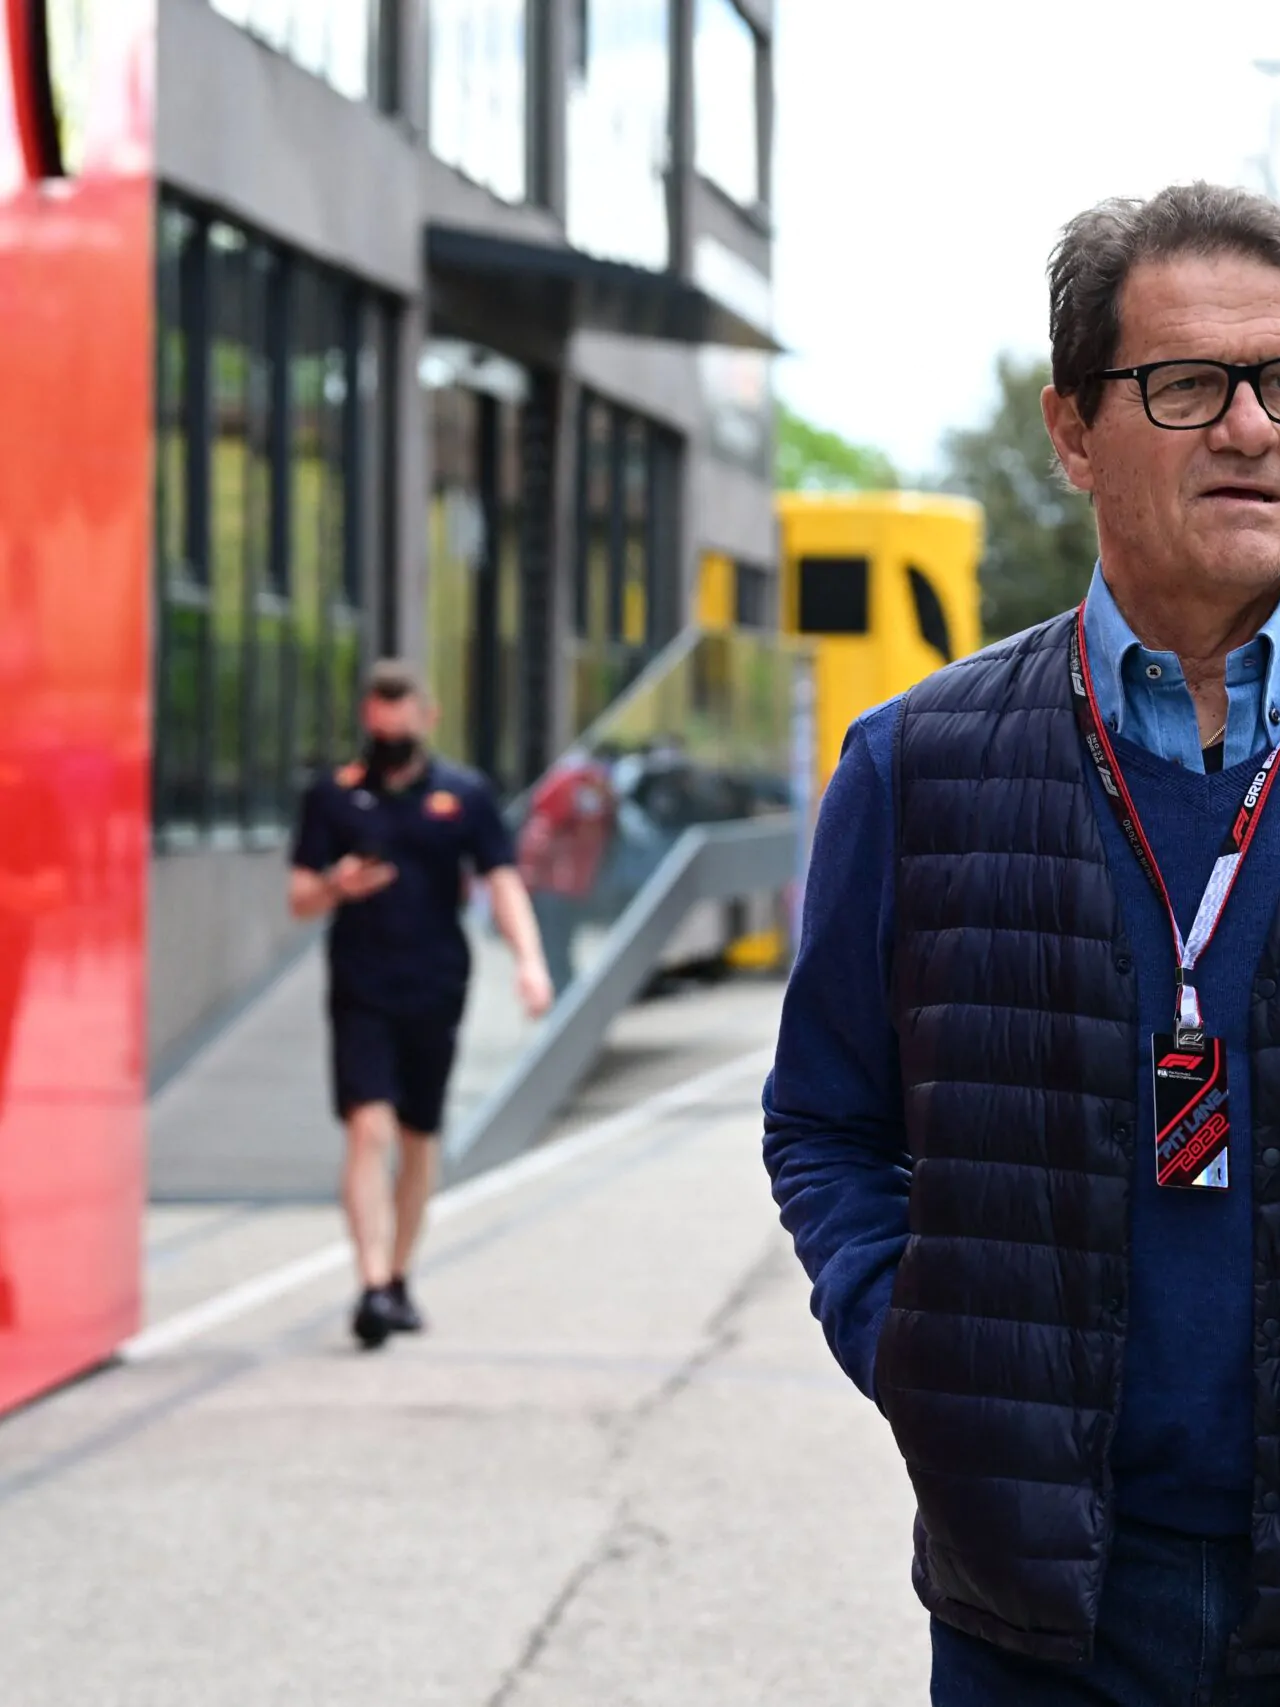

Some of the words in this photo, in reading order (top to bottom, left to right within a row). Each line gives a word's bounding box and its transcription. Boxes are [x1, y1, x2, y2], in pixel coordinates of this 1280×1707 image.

[1243, 770, 1267, 808] GRID
[1122, 819, 1138, 843] 2030
[1158, 1125, 1186, 1160] PIT
[1184, 1087, 1229, 1134] LANE
[1177, 1112, 1226, 1172] 2022
